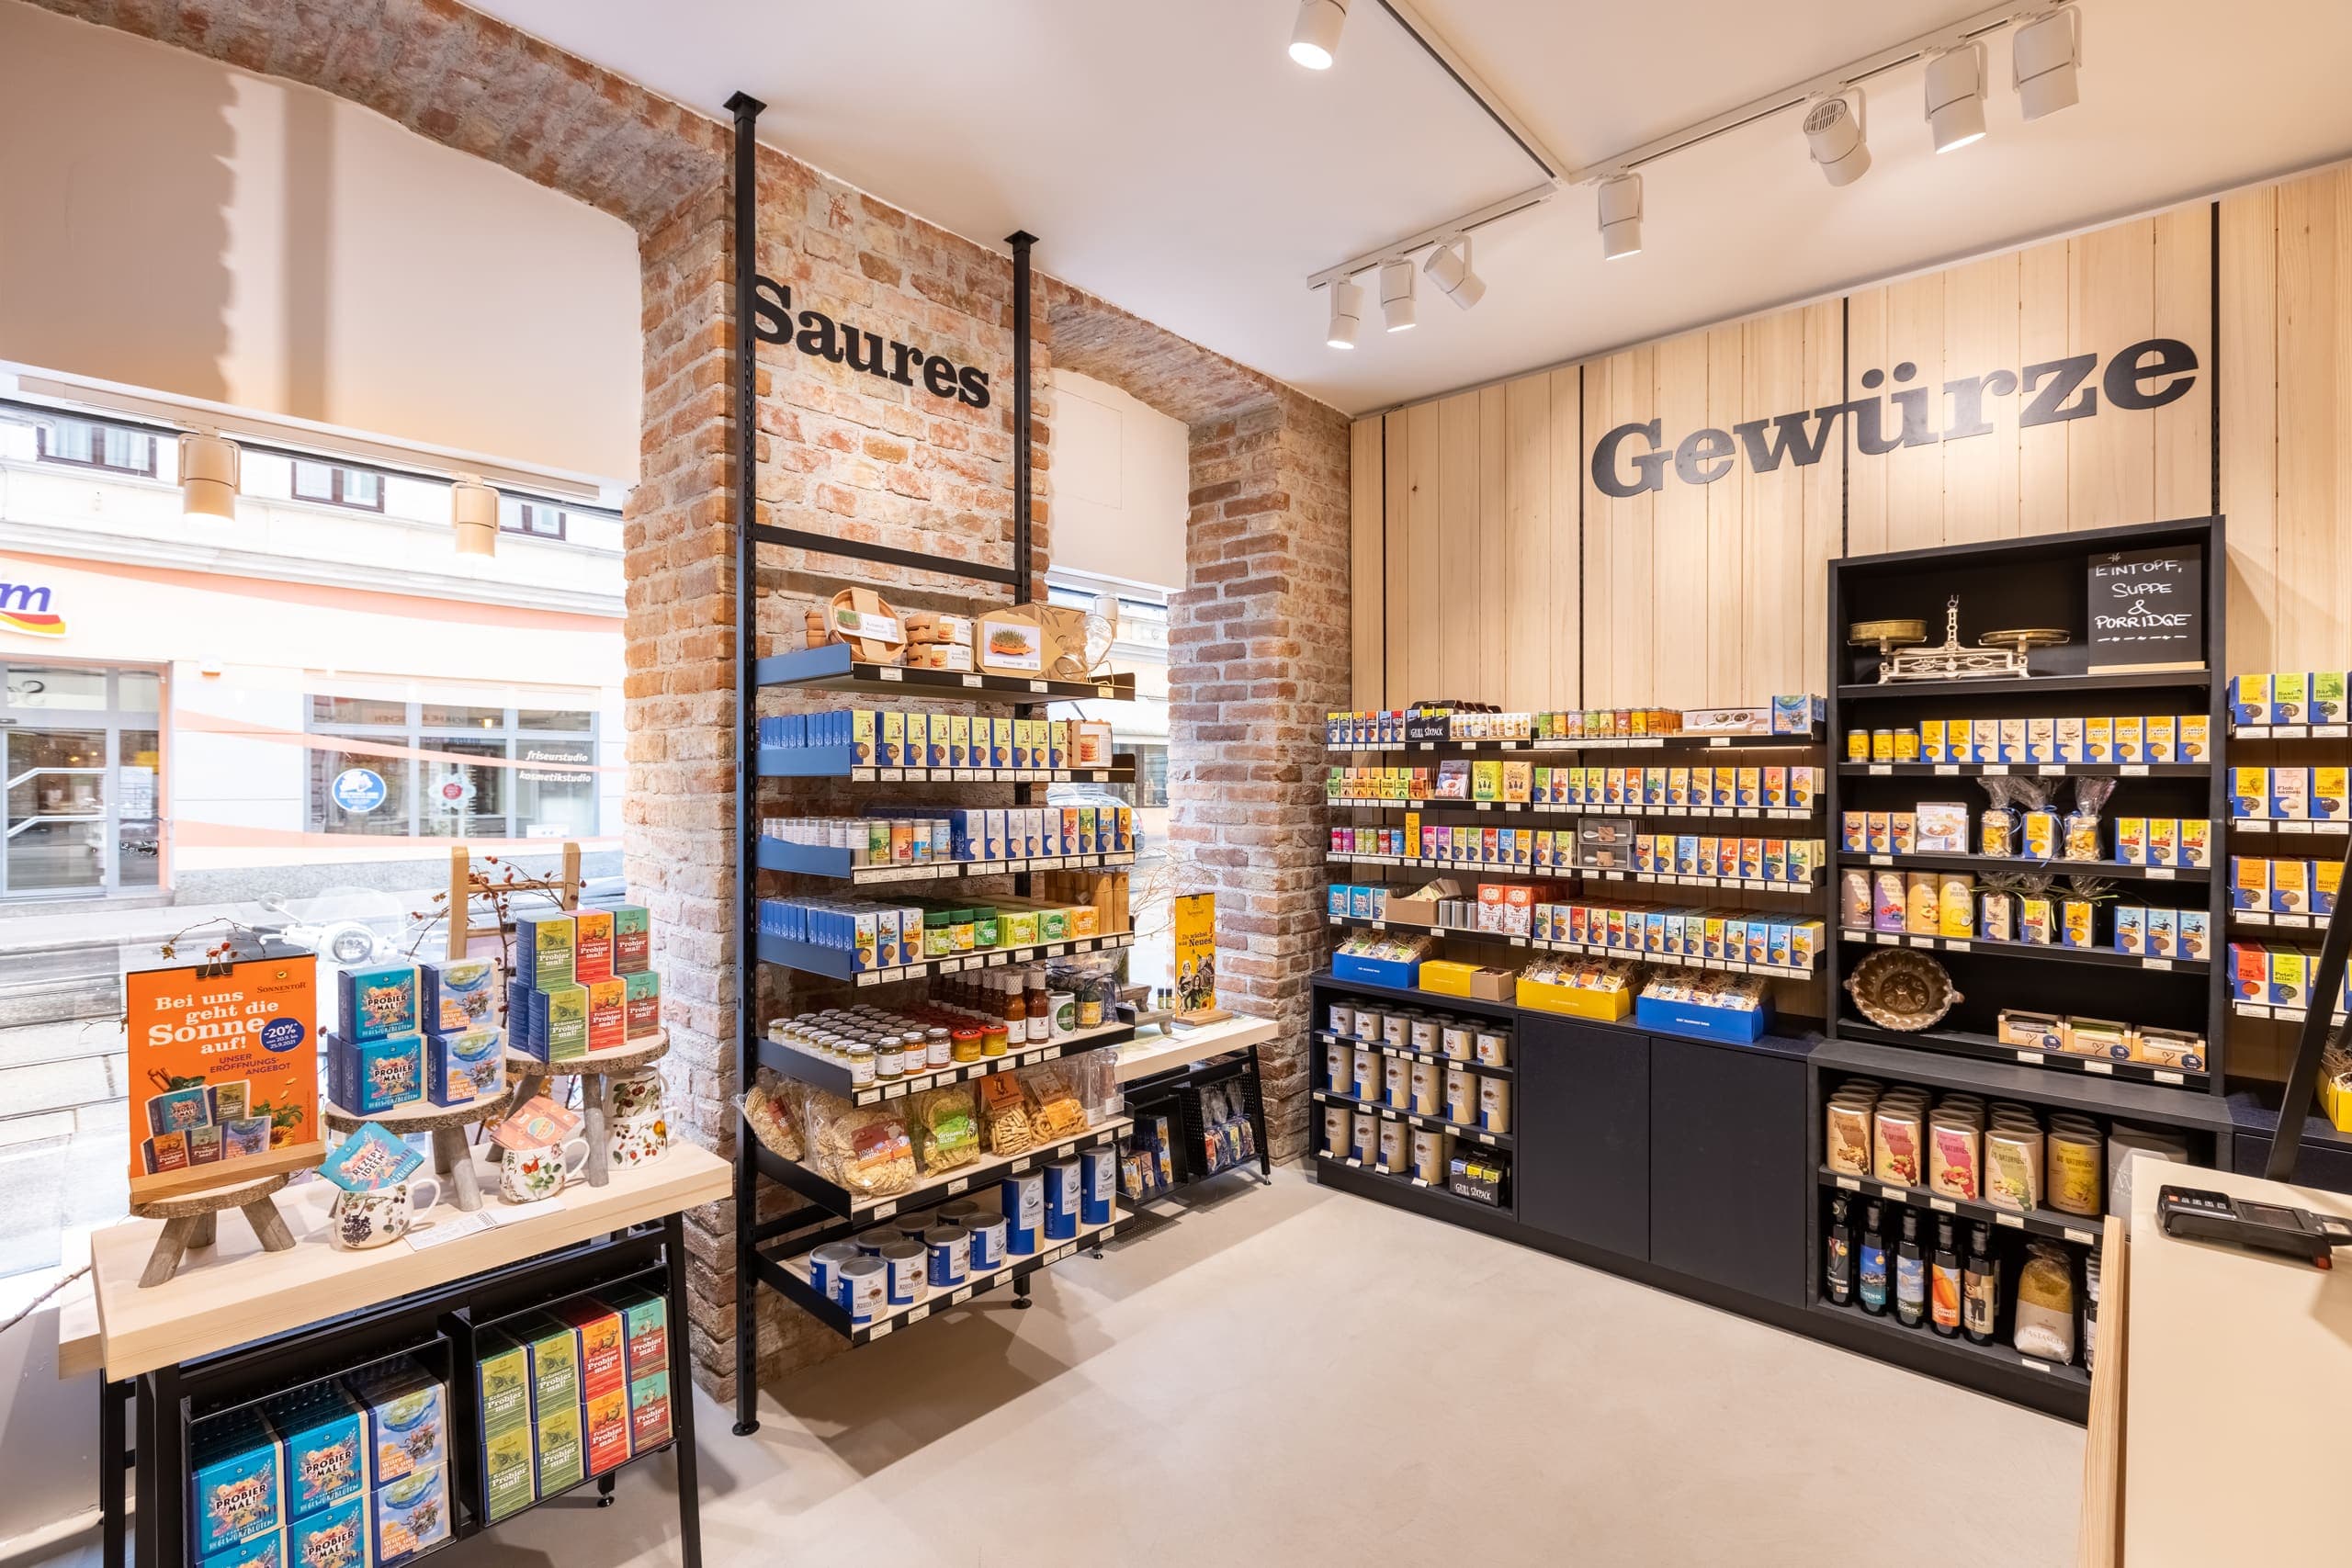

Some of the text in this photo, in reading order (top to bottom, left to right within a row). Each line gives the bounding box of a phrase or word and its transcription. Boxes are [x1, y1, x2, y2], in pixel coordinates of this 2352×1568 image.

[754, 274, 989, 409] Saures
[1590, 338, 2199, 498] Gewürze
[2096, 559, 2183, 577] EINTOPF,
[2111, 582, 2173, 598] SUPPE
[2127, 599, 2152, 615] &
[2095, 614, 2193, 629] PORRIDGE
[526, 750, 588, 762] friseurstudio
[519, 771, 592, 782] kosmetikstudio
[580, 946, 609, 954] Probier
[619, 940, 646, 948] Probier
[1189, 938, 1212, 947] Neues
[539, 953, 570, 962] Probier
[155, 991, 244, 1010] Bei uns
[368, 995, 407, 1006] PROBIER
[377, 1001, 400, 1010] MAL!
[186, 1001, 279, 1025] geht die
[629, 1005, 656, 1014] Probier
[593, 1014, 622, 1022] Probier
[148, 1018, 265, 1047] Sonne
[552, 1024, 583, 1033] Probier
[200, 1036, 247, 1055] auf!
[209, 1057, 279, 1073] ERÖFFNUNGS-
[220, 1054, 252, 1064] UNSER
[245, 1063, 291, 1075] ANGEBOT
[374, 1064, 413, 1077] PROBIER
[383, 1073, 405, 1082] MAL!
[353, 1146, 382, 1176] REZEPT
[361, 1154, 385, 1177] IDEEN
[633, 1337, 662, 1352] Probier
[587, 1354, 618, 1371] Probier
[594, 1362, 613, 1374] mal!
[539, 1371, 572, 1389] Probier
[547, 1380, 566, 1393] mal!
[488, 1391, 523, 1408] Probier
[495, 1399, 515, 1413] mal!
[637, 1406, 666, 1423] Probier
[592, 1426, 623, 1444] Probier
[599, 1435, 618, 1448] mal!
[306, 1450, 352, 1473] PROBIER
[543, 1447, 576, 1465] Probier
[550, 1455, 570, 1468] mal!
[317, 1462, 342, 1478] MAL!
[492, 1468, 526, 1486] Probier
[500, 1477, 519, 1490] mal!
[216, 1484, 266, 1509] PROBIER
[228, 1496, 256, 1513] MAL!
[308, 1530, 355, 1555] PROBIER
[319, 1542, 345, 1560] MAL!
